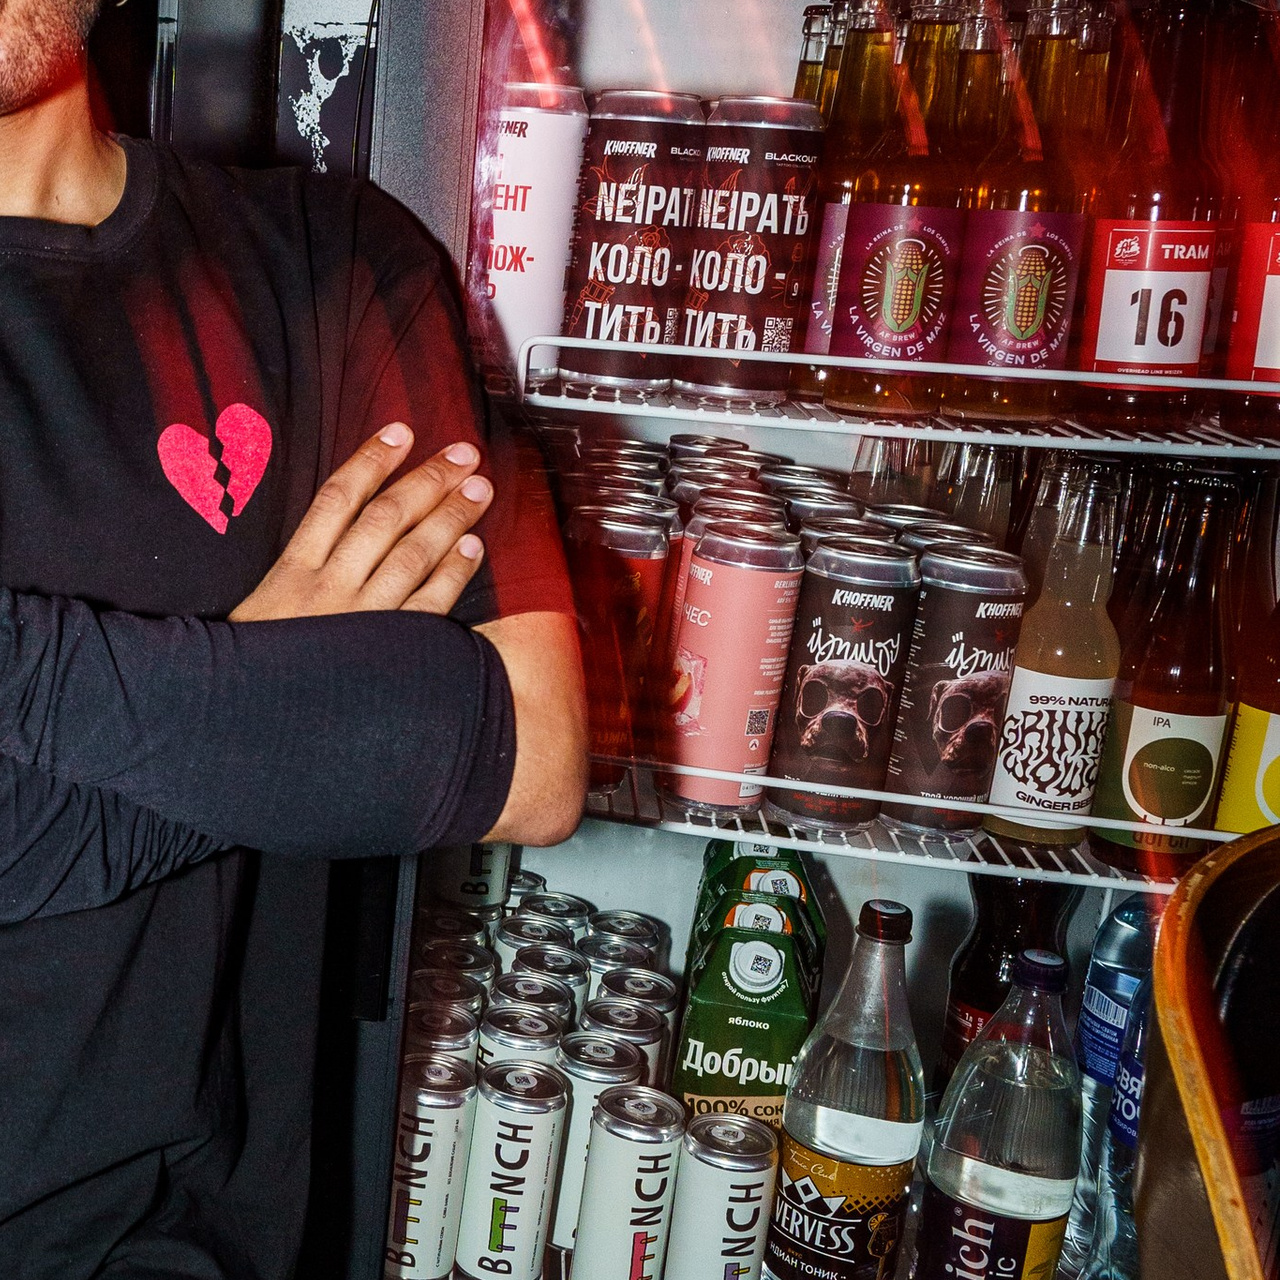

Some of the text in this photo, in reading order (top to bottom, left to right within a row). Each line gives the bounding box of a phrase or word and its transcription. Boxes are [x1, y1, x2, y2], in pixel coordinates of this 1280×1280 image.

[603, 140, 657, 159] KHOFFNER
[706, 146, 818, 164] KHOFFNER BLACKOUT
[894, 223, 905, 232] DE
[922, 225, 936, 236] LOS
[1046, 231, 1058, 241] LOS
[1161, 244, 1210, 260] TRAM
[584, 300, 661, 347] ТИТЬ
[1130, 288, 1188, 347] 16
[684, 308, 757, 352] ТИТЬ
[849, 306, 863, 329] LA
[856, 327, 902, 358] VIRGEN
[906, 342, 924, 356] DE
[926, 311, 947, 345] MAIZ
[879, 330, 916, 342] AF BREW
[969, 314, 983, 334] LA
[977, 333, 1025, 365] VIRGEN
[1031, 349, 1049, 363] DE
[1001, 338, 1039, 350] AF BREW
[832, 589, 894, 612] KHOFFNER
[1029, 695, 1066, 706] 99%
[1153, 716, 1171, 729] IPA
[1143, 762, 1175, 772] non-alco
[1016, 790, 1071, 811] GINGER
[721, 970, 787, 1004] открой пользу фруктов
[728, 1017, 770, 1030] яблоко
[687, 1098, 784, 1116] 100% сок
[810, 1163, 836, 1181] Club
[775, 1195, 857, 1254] VERVESS
[770, 1241, 838, 1280] НДИАН ТОНИК
